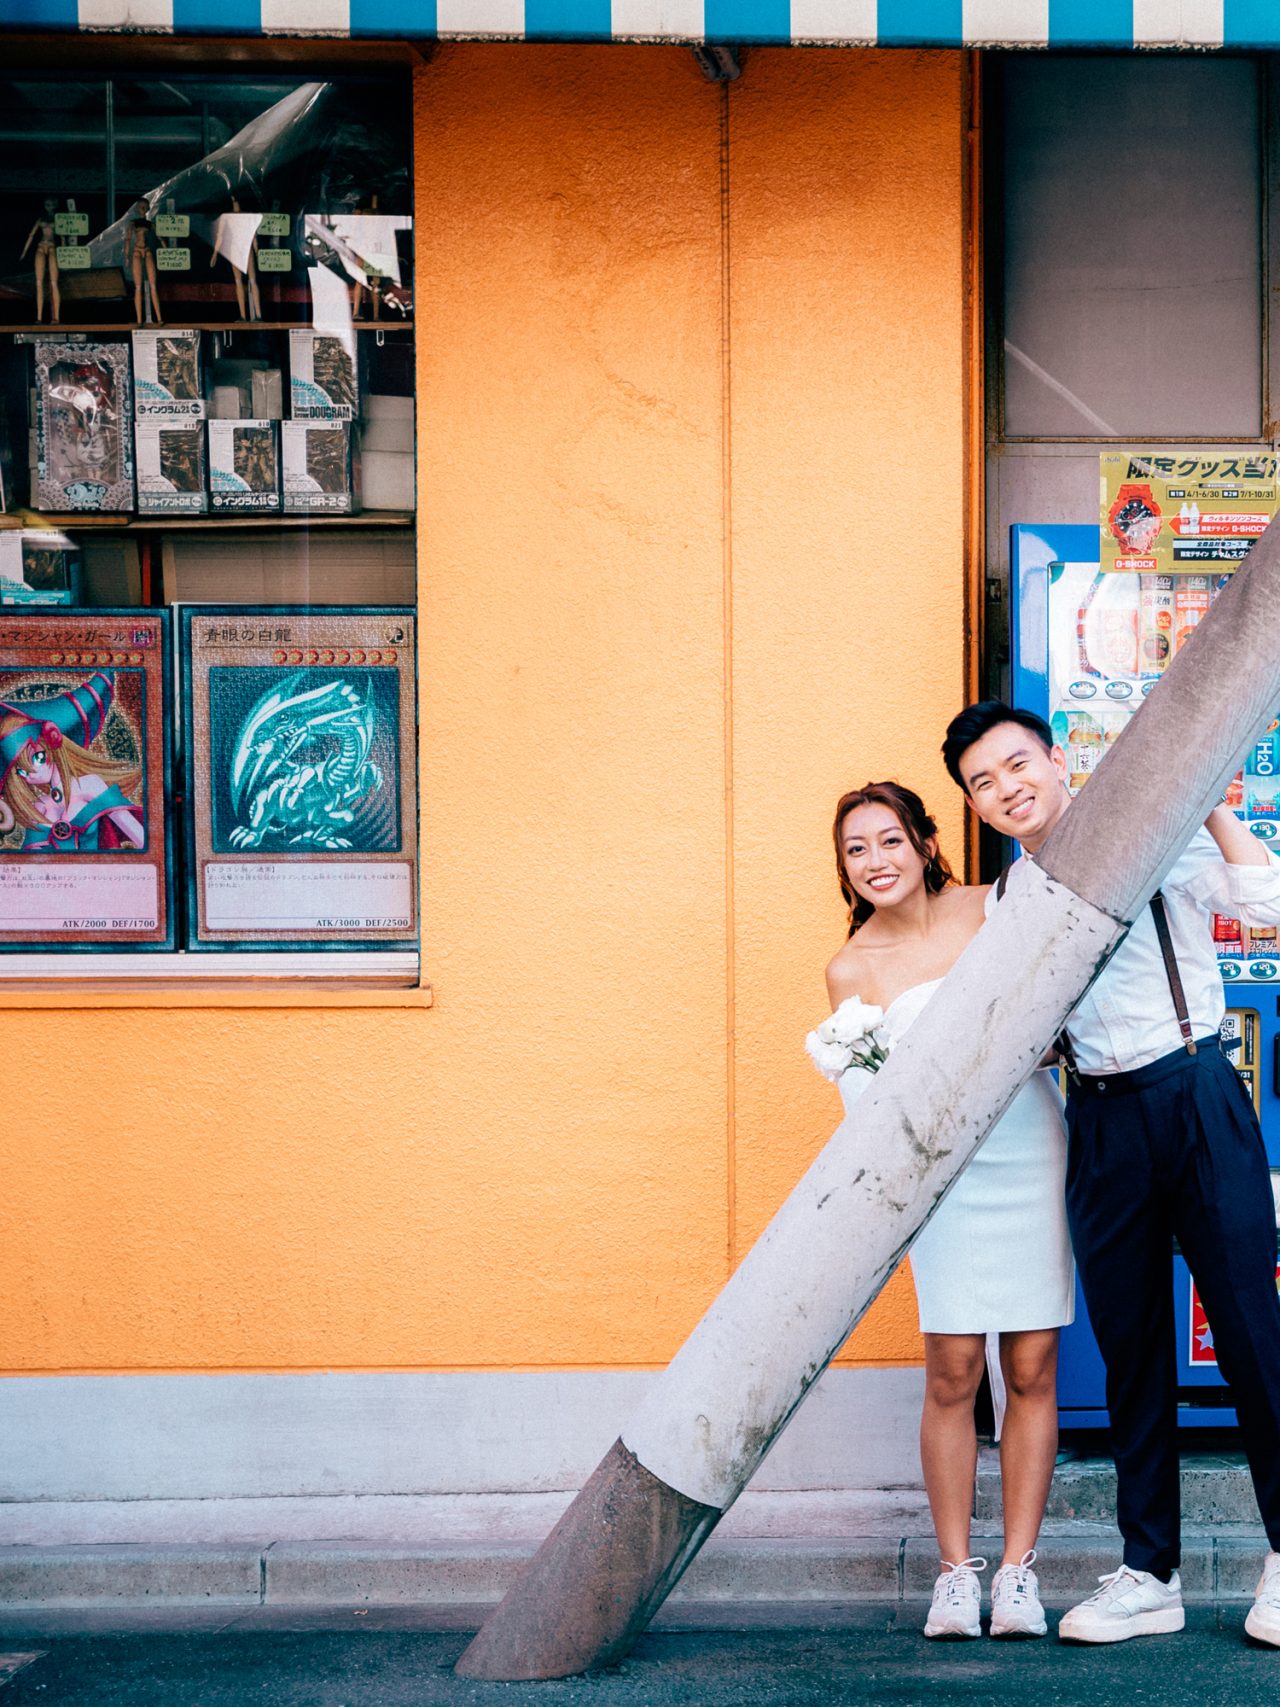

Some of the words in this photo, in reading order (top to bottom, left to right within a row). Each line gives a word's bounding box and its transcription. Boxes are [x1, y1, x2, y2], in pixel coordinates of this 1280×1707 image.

[310, 406, 350, 418] DOUGRAM
[1187, 490, 1220, 498] 4/1-6/30
[1240, 490, 1274, 498] 7/1-10/31
[1116, 560, 1155, 568] G-SHOCK
[204, 627, 292, 642] 青眼の白龍
[1257, 742, 1274, 775] H2O
[62, 920, 107, 928] ATK/2000
[112, 920, 155, 928] DEF/1700
[316, 919, 360, 927] ATK/3000
[365, 919, 409, 927] DEF/2500
